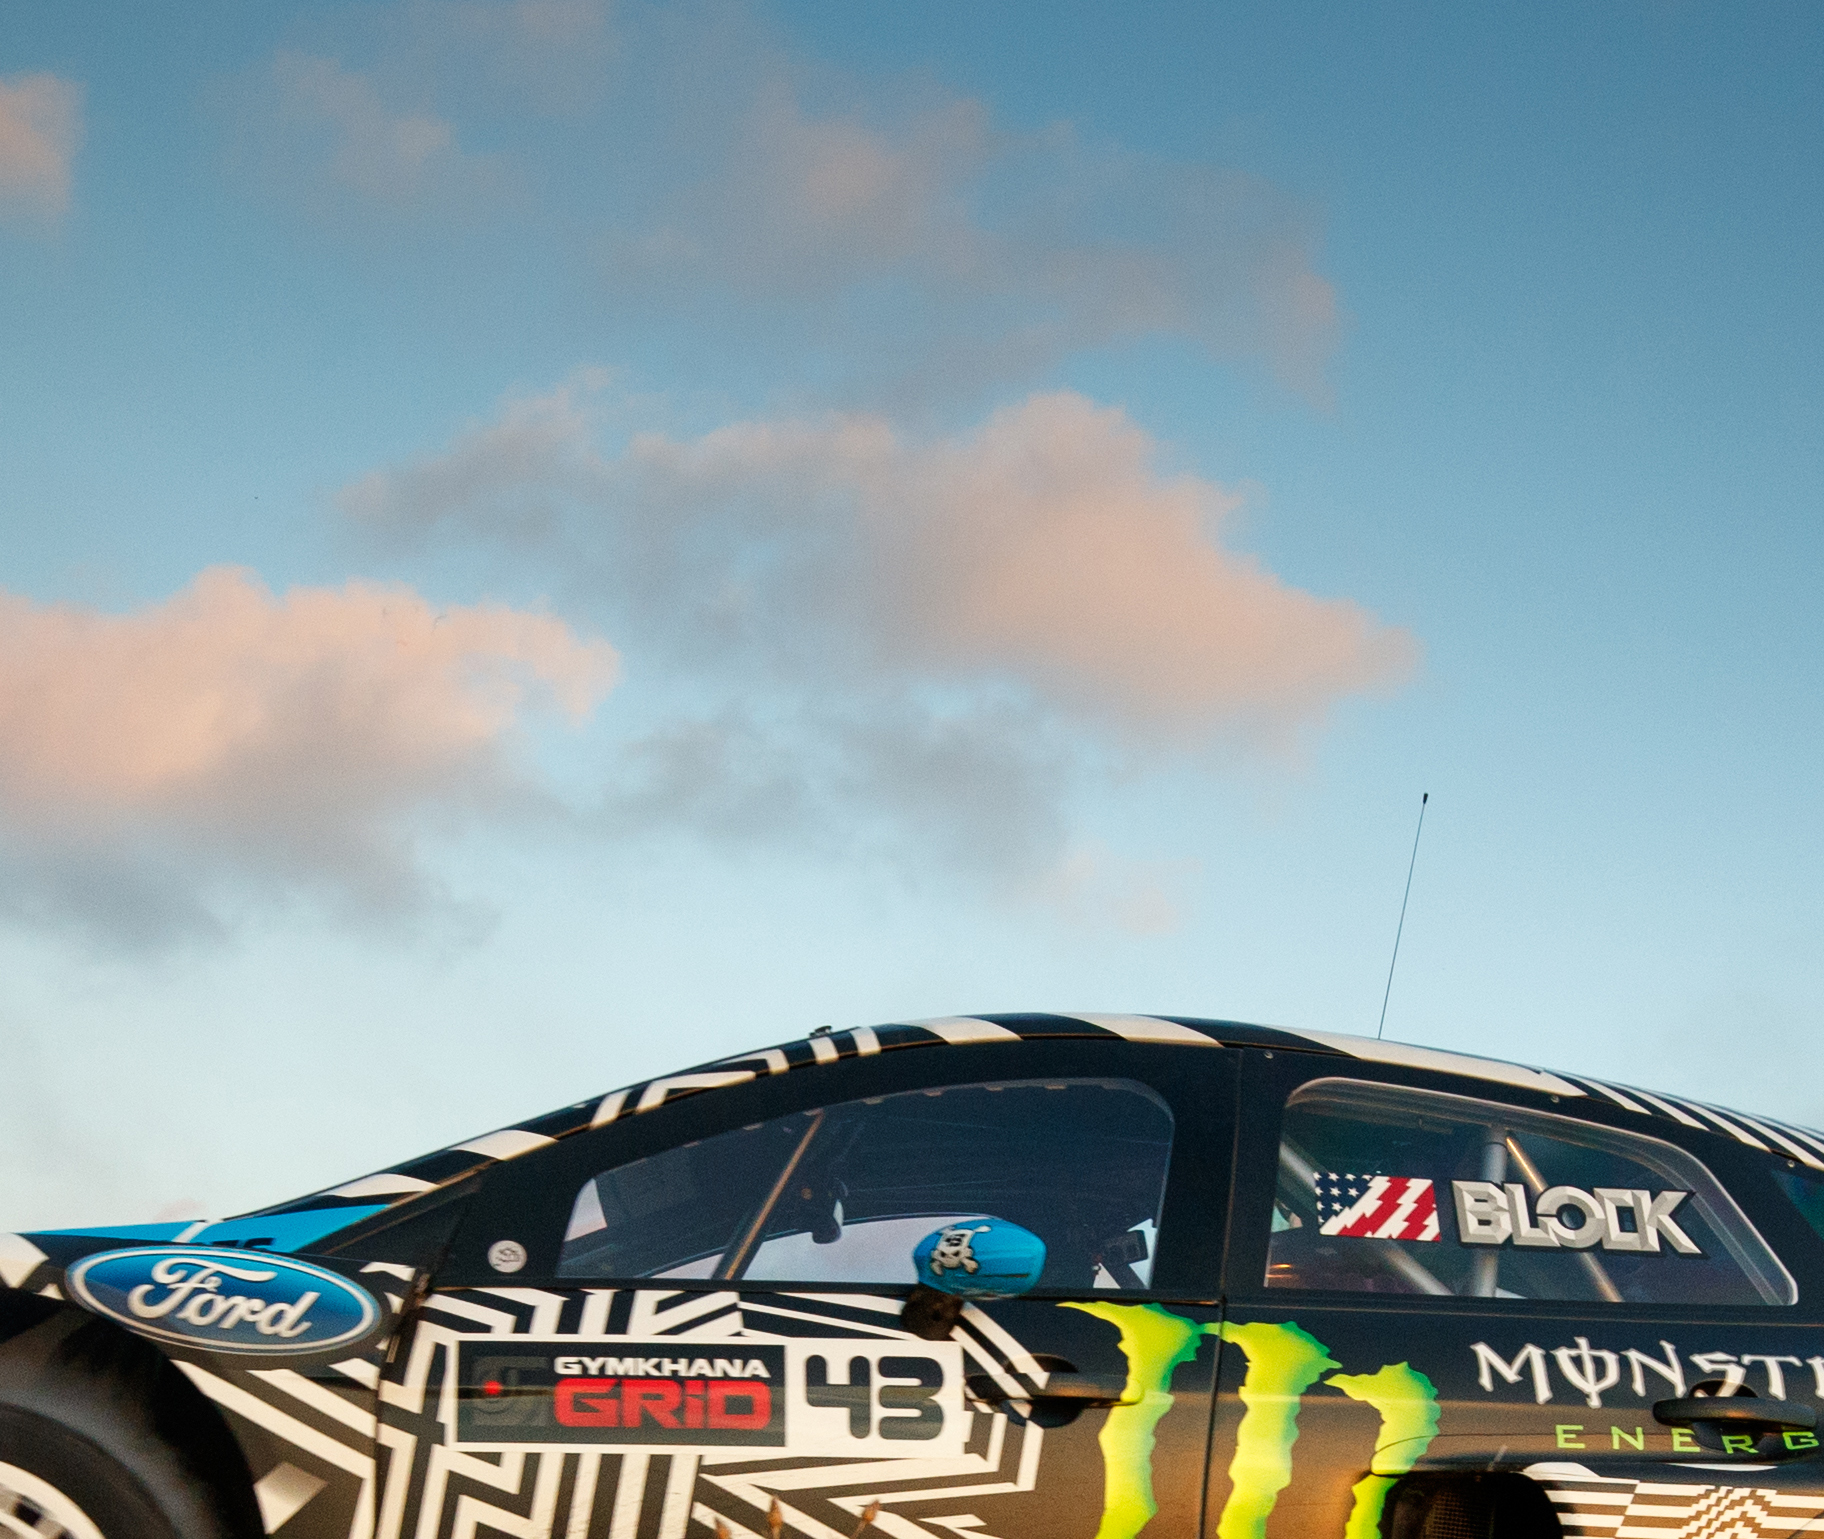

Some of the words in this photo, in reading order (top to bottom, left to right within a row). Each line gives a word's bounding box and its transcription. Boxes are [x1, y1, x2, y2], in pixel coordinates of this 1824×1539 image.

[1451, 1179, 1702, 1254] BLOCK
[127, 1256, 321, 1338] Ford
[553, 1356, 772, 1378] GYMKHANA
[805, 1354, 945, 1440] 43
